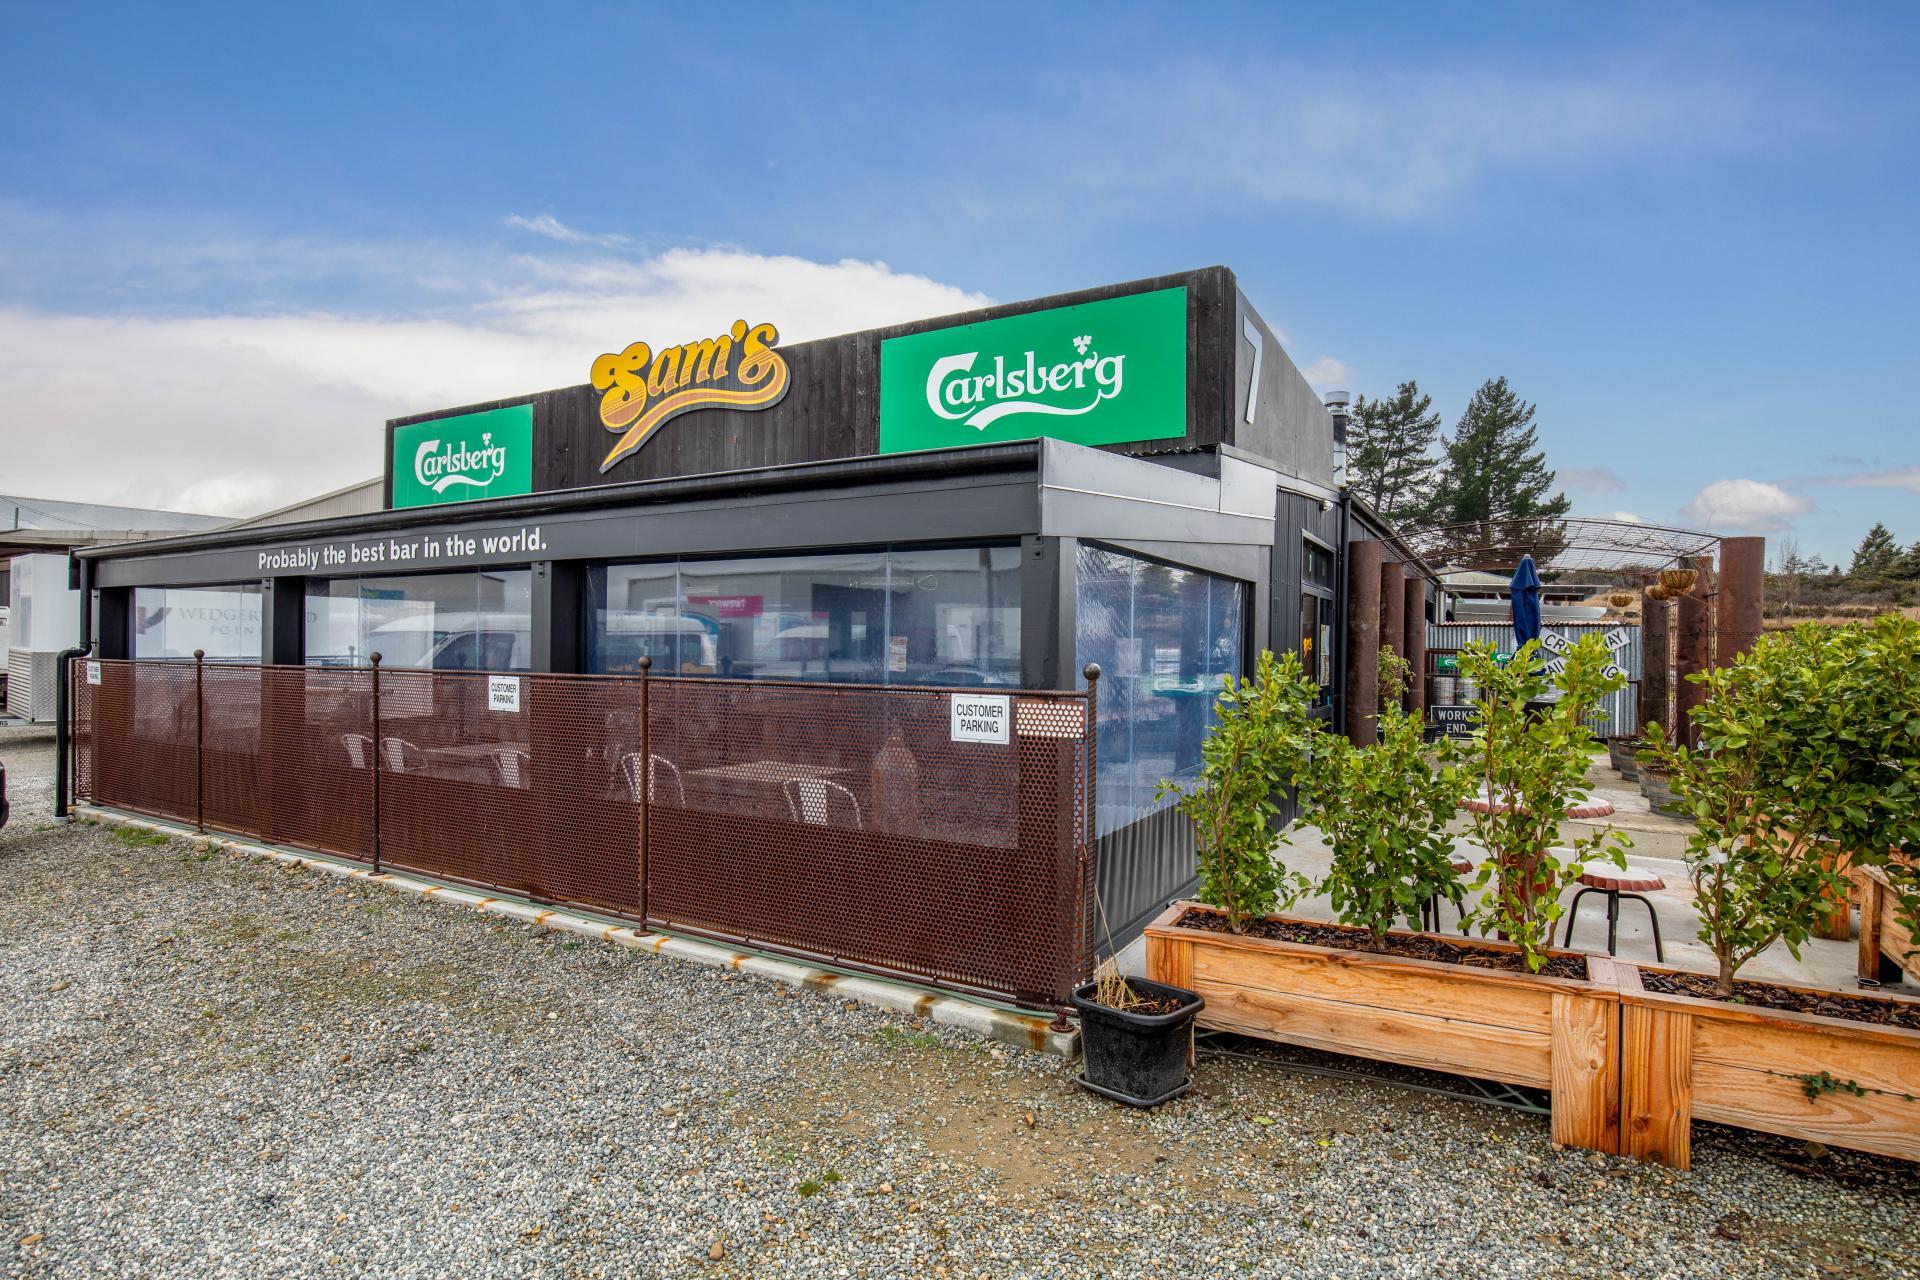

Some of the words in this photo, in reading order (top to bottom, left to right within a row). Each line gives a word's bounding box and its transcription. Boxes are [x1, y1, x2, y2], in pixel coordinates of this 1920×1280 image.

[1242, 314, 1263, 425] 7
[590, 319, 788, 472] Sam's
[926, 350, 1126, 431] Carlsberg
[414, 439, 507, 494] Carlsberg
[258, 547, 320, 571] Probably
[323, 544, 347, 565] the
[351, 542, 386, 563] best
[390, 539, 419, 560] bar
[424, 536, 440, 558] in
[445, 534, 477, 557] the
[482, 527, 547, 554] world.
[491, 683, 517, 693] CUSTOMER
[493, 694, 514, 704] PARKING
[956, 704, 1003, 718] CUSTOMER
[1438, 710, 1475, 720] WORKS
[960, 720, 998, 733] PARKING
[1446, 724, 1467, 733] END
